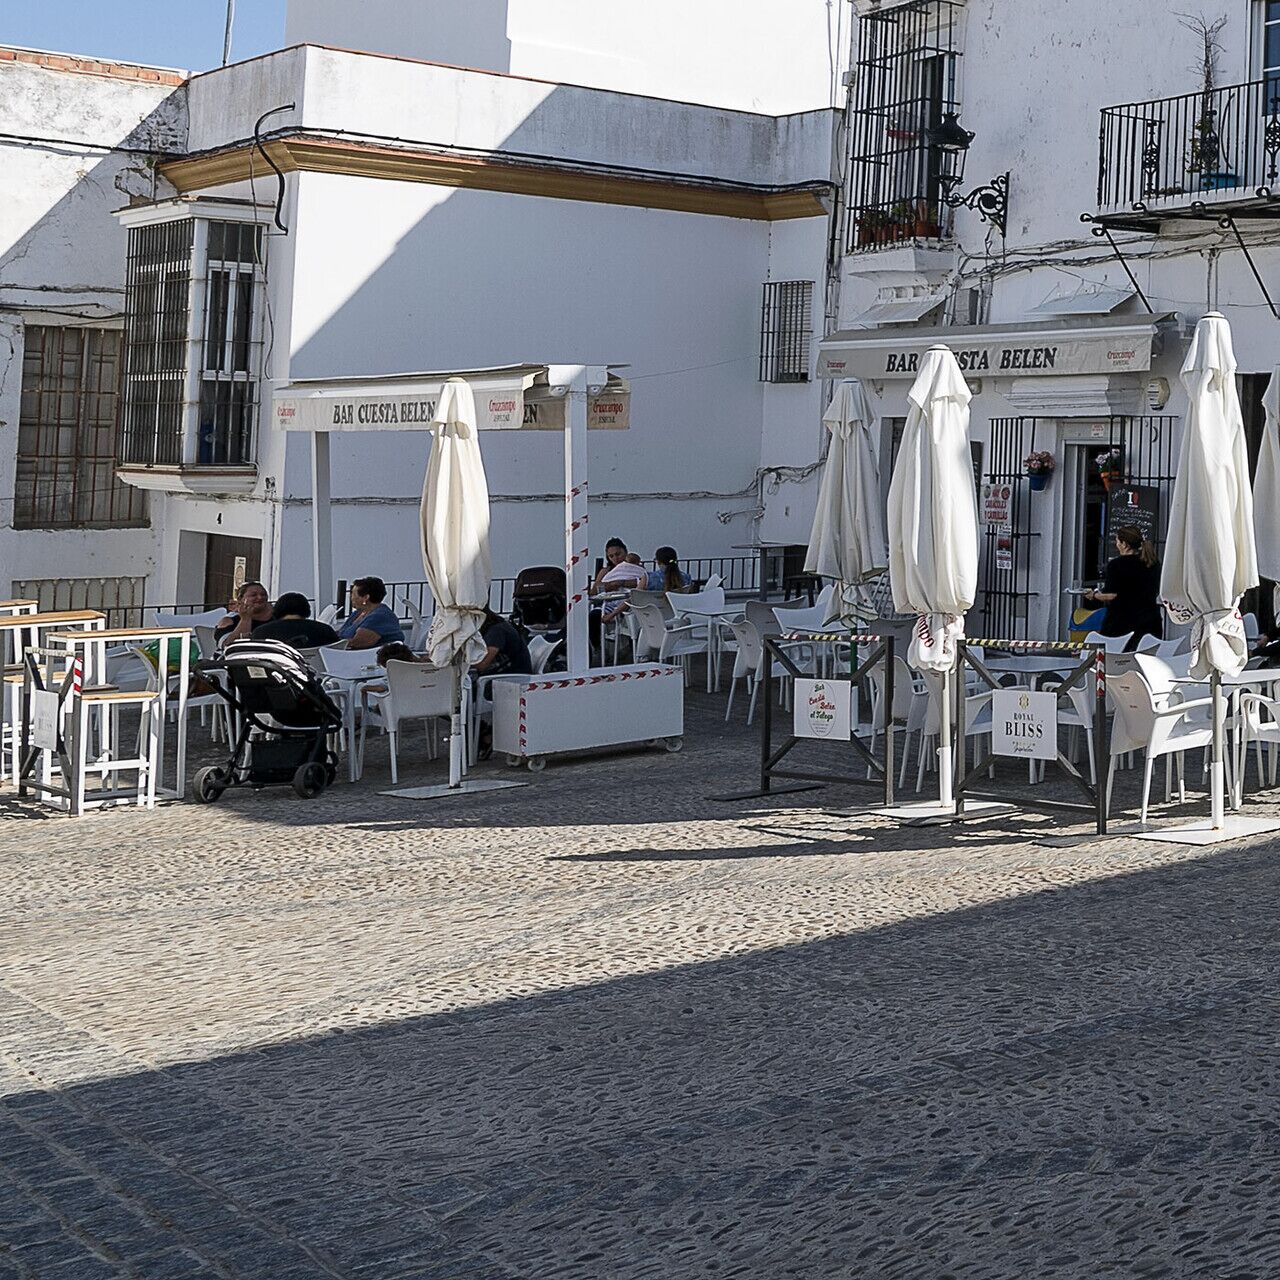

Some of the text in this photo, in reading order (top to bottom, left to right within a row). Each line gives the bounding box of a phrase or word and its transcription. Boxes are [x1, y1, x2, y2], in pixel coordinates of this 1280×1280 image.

[885, 353, 919, 372] BAR
[1000, 348, 1058, 370] BELEN
[1107, 350, 1136, 360] Cruzcampo
[333, 401, 436, 424] BAR CUESTA BELEN
[593, 398, 624, 414] Cruzcampo
[1013, 712, 1034, 721] ROYAL
[1005, 721, 1043, 738] BLISS
